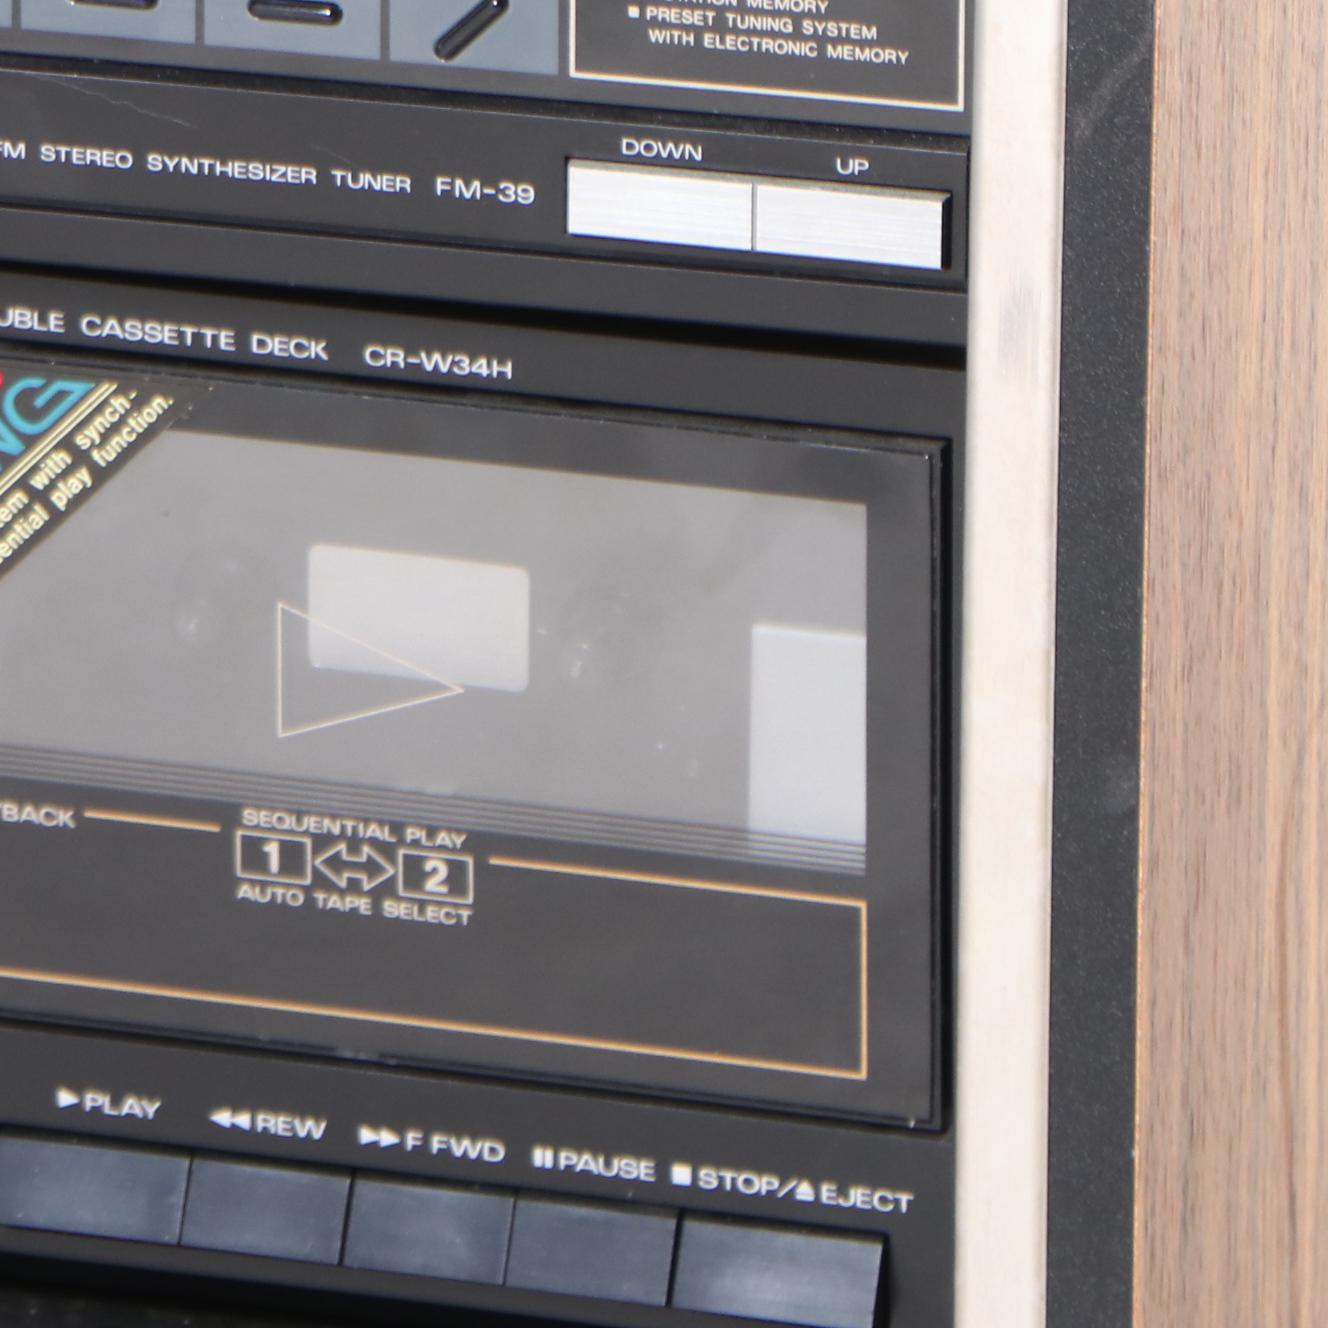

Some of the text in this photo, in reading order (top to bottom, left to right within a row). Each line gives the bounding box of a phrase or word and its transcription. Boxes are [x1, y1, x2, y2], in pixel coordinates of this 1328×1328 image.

[647, 7, 877, 40] PRESET TUNING SYSTEM
[648, 29, 909, 64] WITH ELECTRONIC MEMORY
[621, 137, 703, 162] DOWN
[836, 156, 869, 176] UP
[39, 145, 133, 169] STEREO
[147, 152, 317, 184] SYNTHESIZER
[331, 170, 411, 194] TUNER
[435, 177, 536, 204] FM-39
[80, 316, 235, 351] CASSETTE
[252, 336, 329, 361] DECK
[364, 344, 513, 380] CR-W34H
[29, 449, 72, 491] with
[74, 391, 138, 451] synch-
[50, 465, 93, 510] play
[242, 808, 466, 851] SEQUENTIAL PLAY
[84, 1091, 162, 1120] PLAY
[256, 1113, 328, 1140] REW
[431, 1135, 506, 1163] FWD
[559, 1149, 656, 1182] PAUSE
